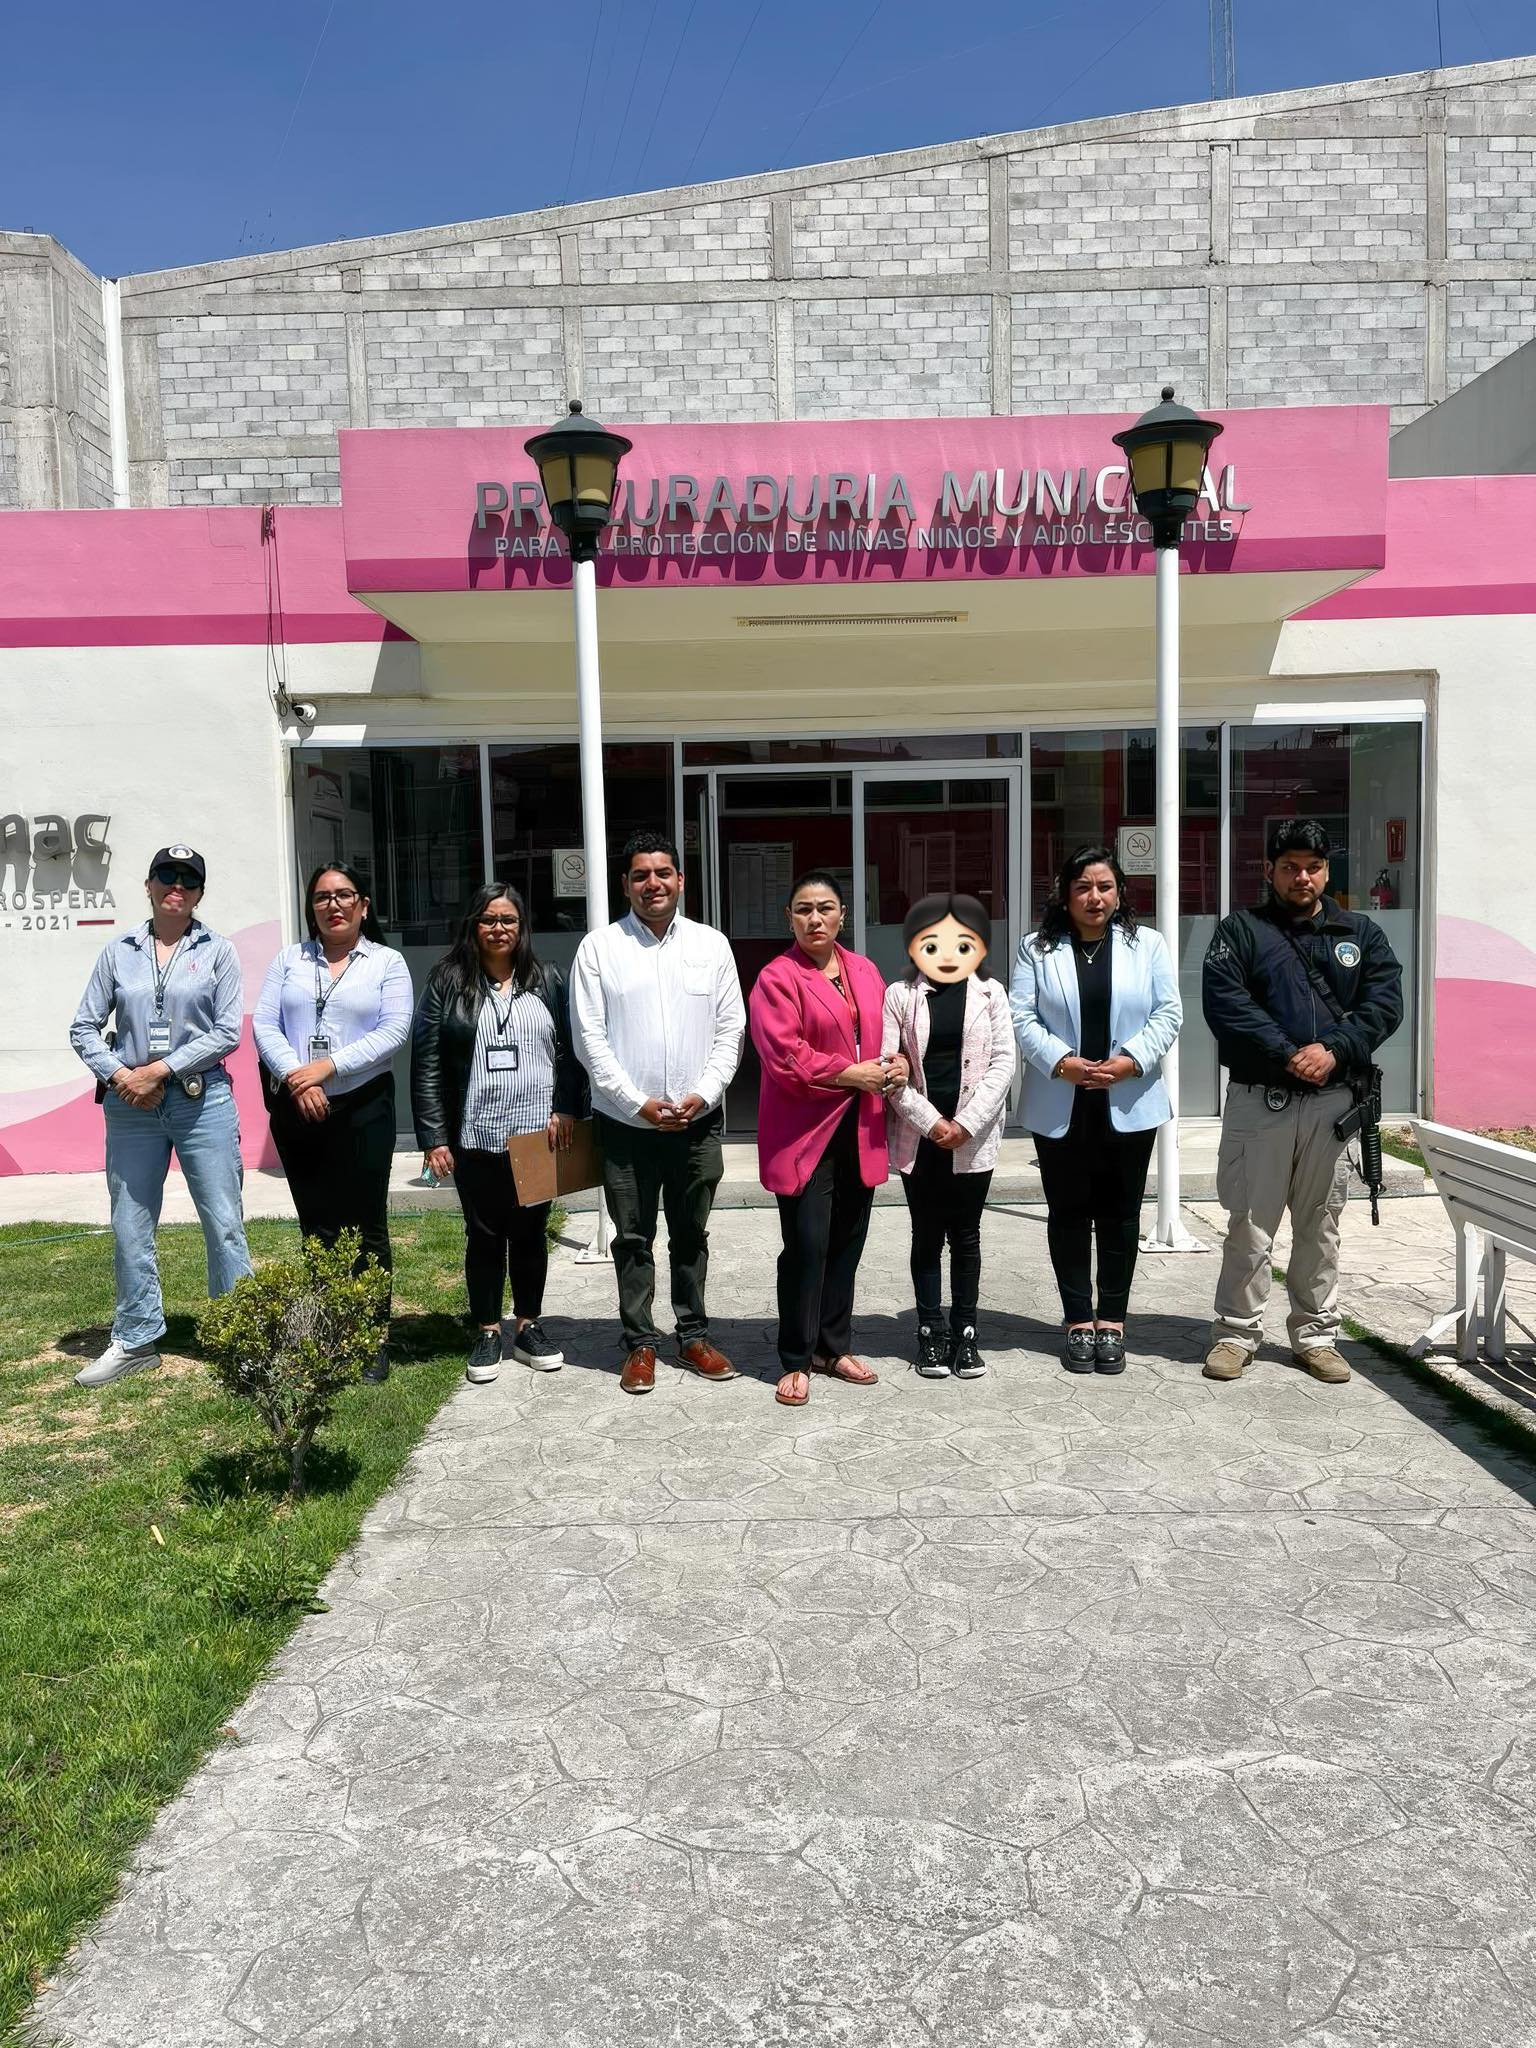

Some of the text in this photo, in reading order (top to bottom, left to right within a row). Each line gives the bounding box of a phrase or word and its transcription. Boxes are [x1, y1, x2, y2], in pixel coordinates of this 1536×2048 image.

[476, 464, 1251, 529] PRURADURIA MUNICAL
[494, 536, 562, 558] PARA
[613, 526, 774, 556] PROTECCIÓN
[785, 530, 817, 552] DE
[828, 524, 907, 552] NIÑAS
[918, 522, 998, 550] NIÑOS
[1007, 524, 1023, 547] Y
[1033, 519, 1233, 546] ADOLESCTES
[22, 914, 70, 931] 2021
